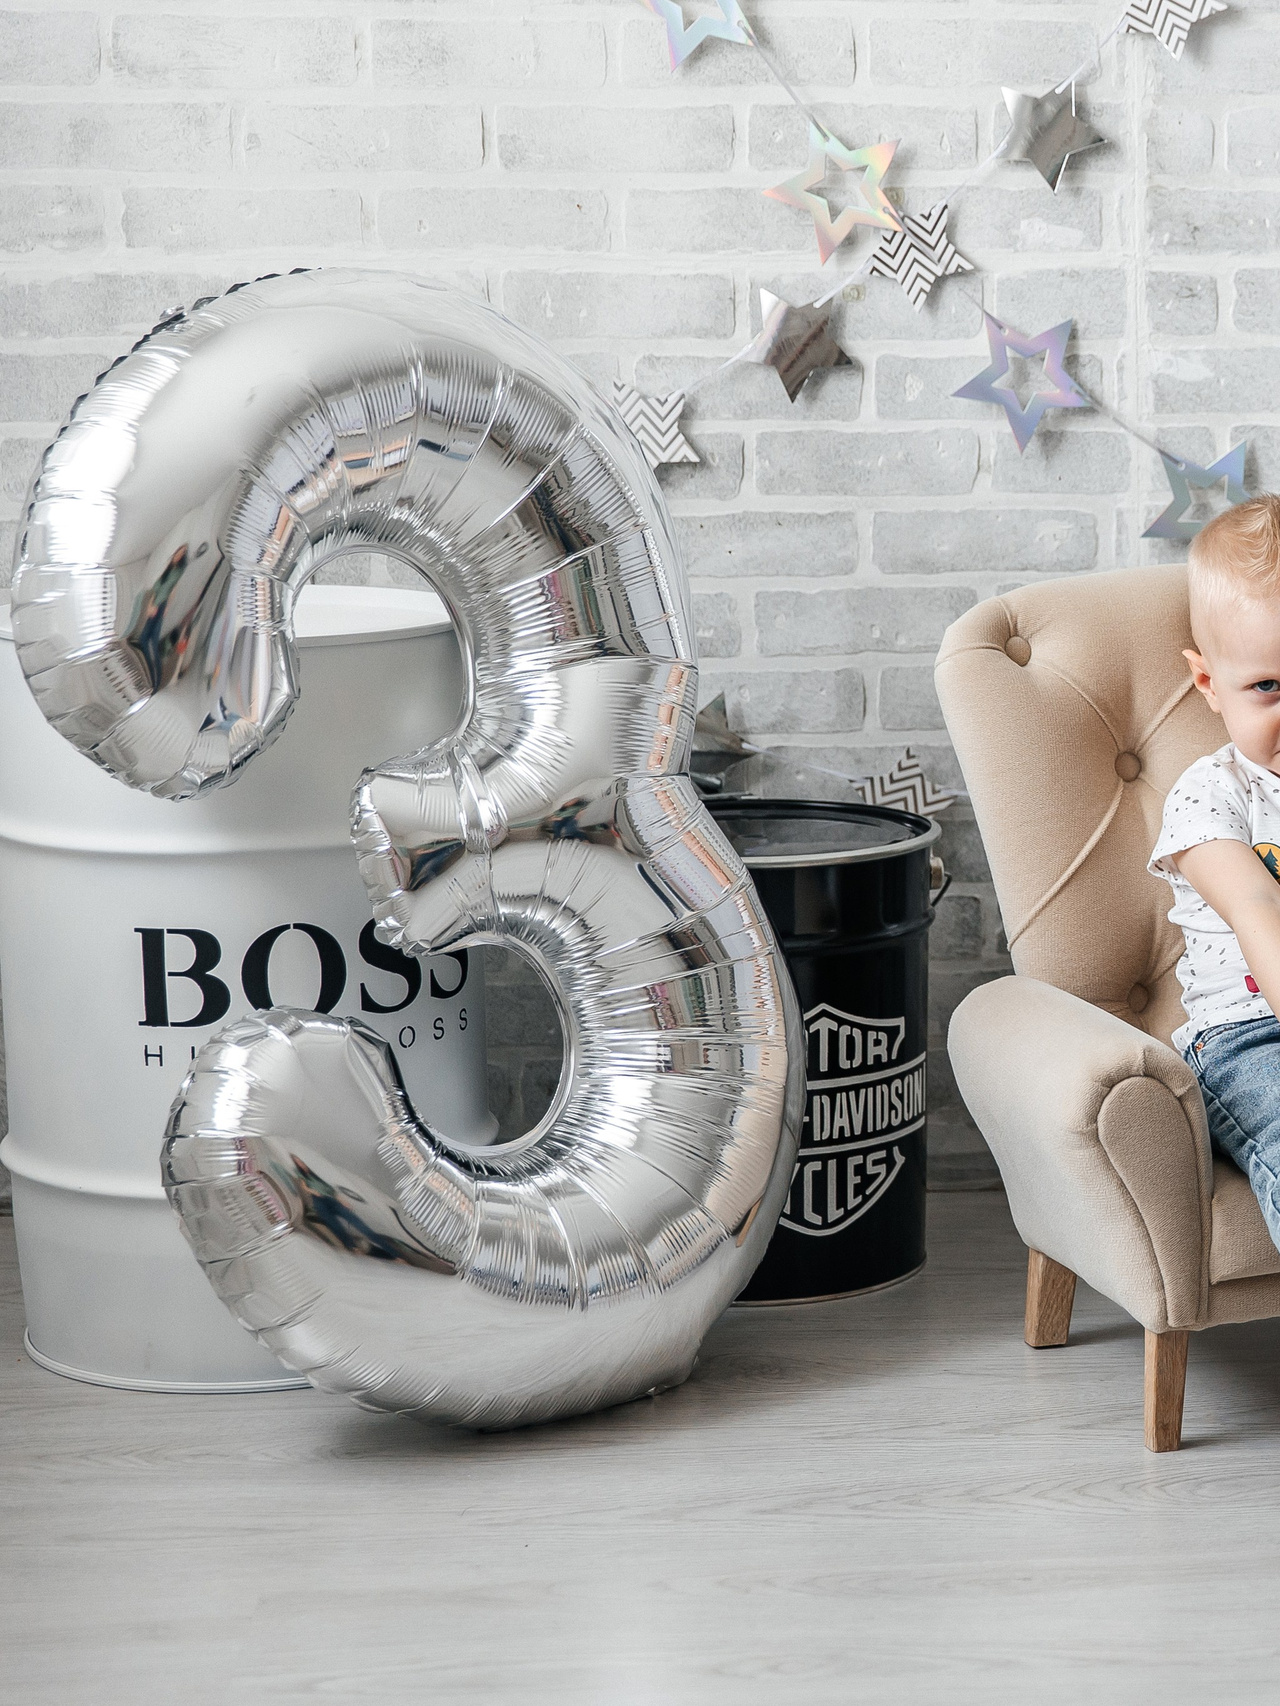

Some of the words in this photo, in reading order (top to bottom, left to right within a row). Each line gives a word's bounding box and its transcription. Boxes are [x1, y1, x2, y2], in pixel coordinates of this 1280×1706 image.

[398, 1007, 468, 1049] OSS
[805, 1016, 888, 1073] TOR
[803, 1067, 923, 1142] -DAVIDSON
